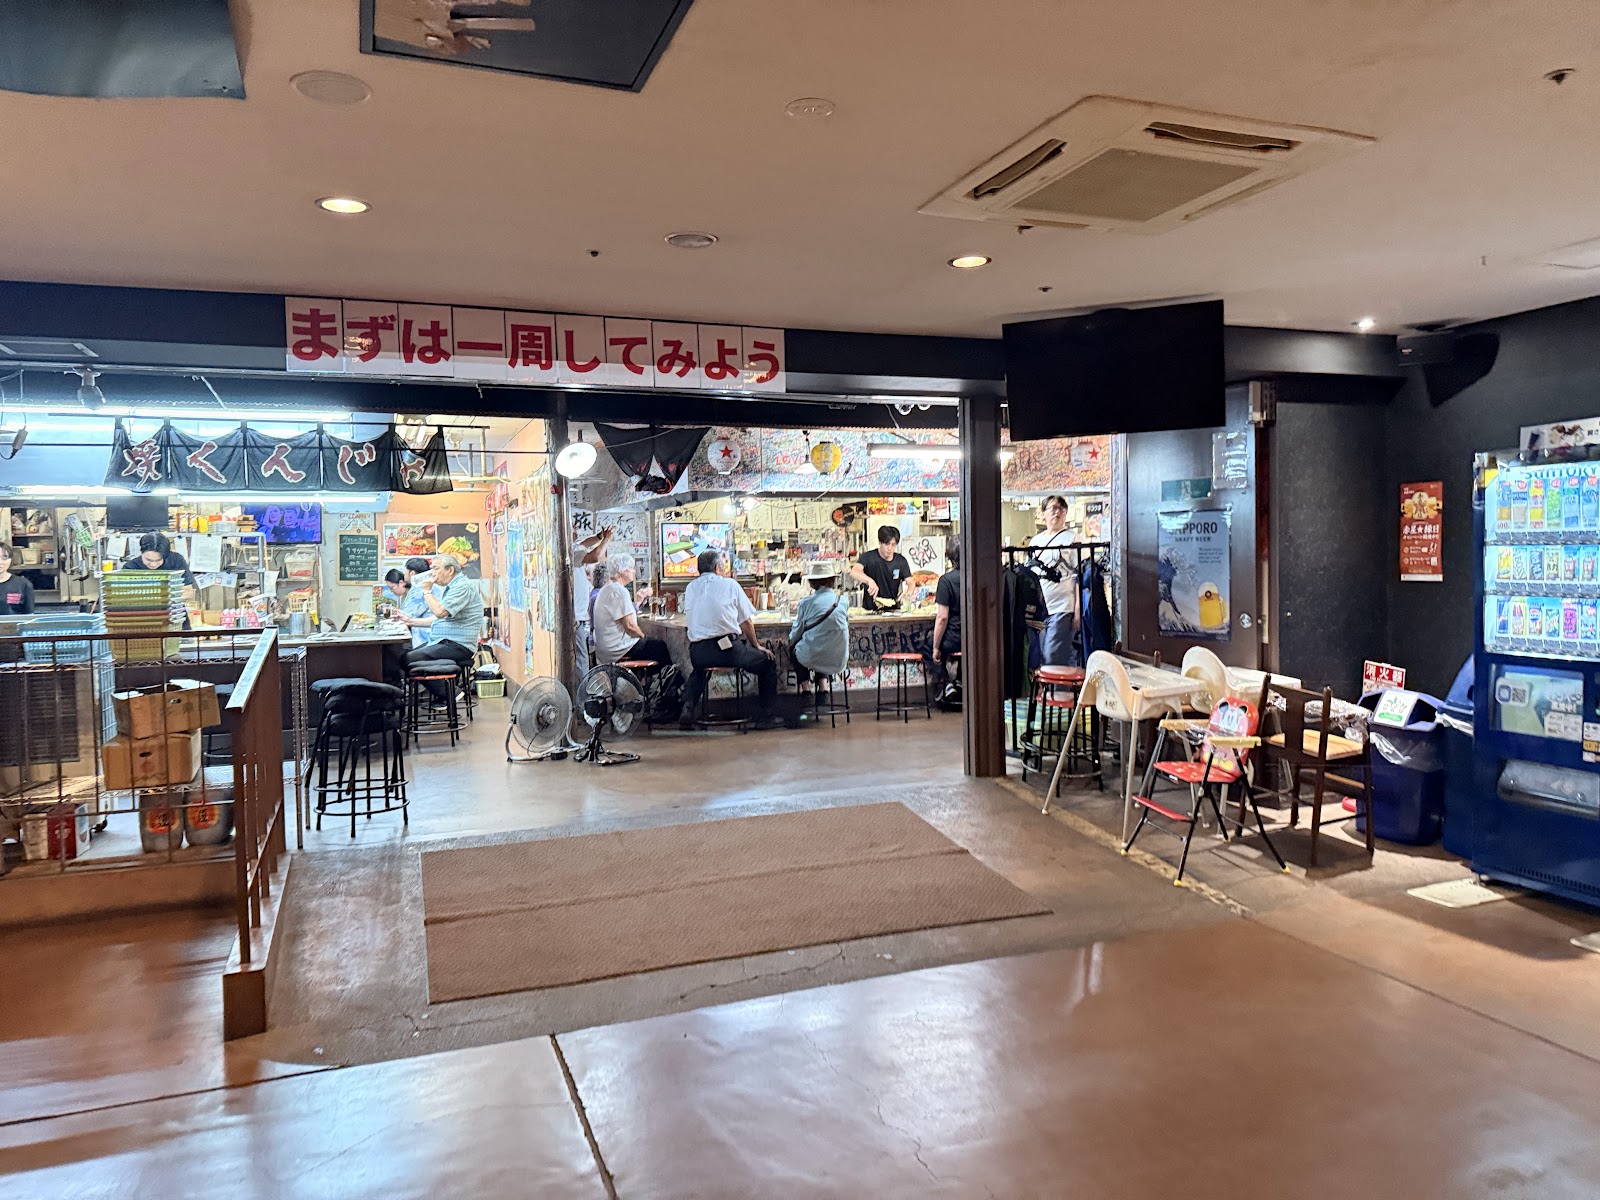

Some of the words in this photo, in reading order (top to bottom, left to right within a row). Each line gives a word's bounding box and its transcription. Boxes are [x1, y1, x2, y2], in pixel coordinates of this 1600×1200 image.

[291, 307, 780, 383] まずは一周してみよう
[573, 511, 593, 531] 旅
[1169, 522, 1218, 535] PPORO
[1365, 664, 1403, 684] 消火器
